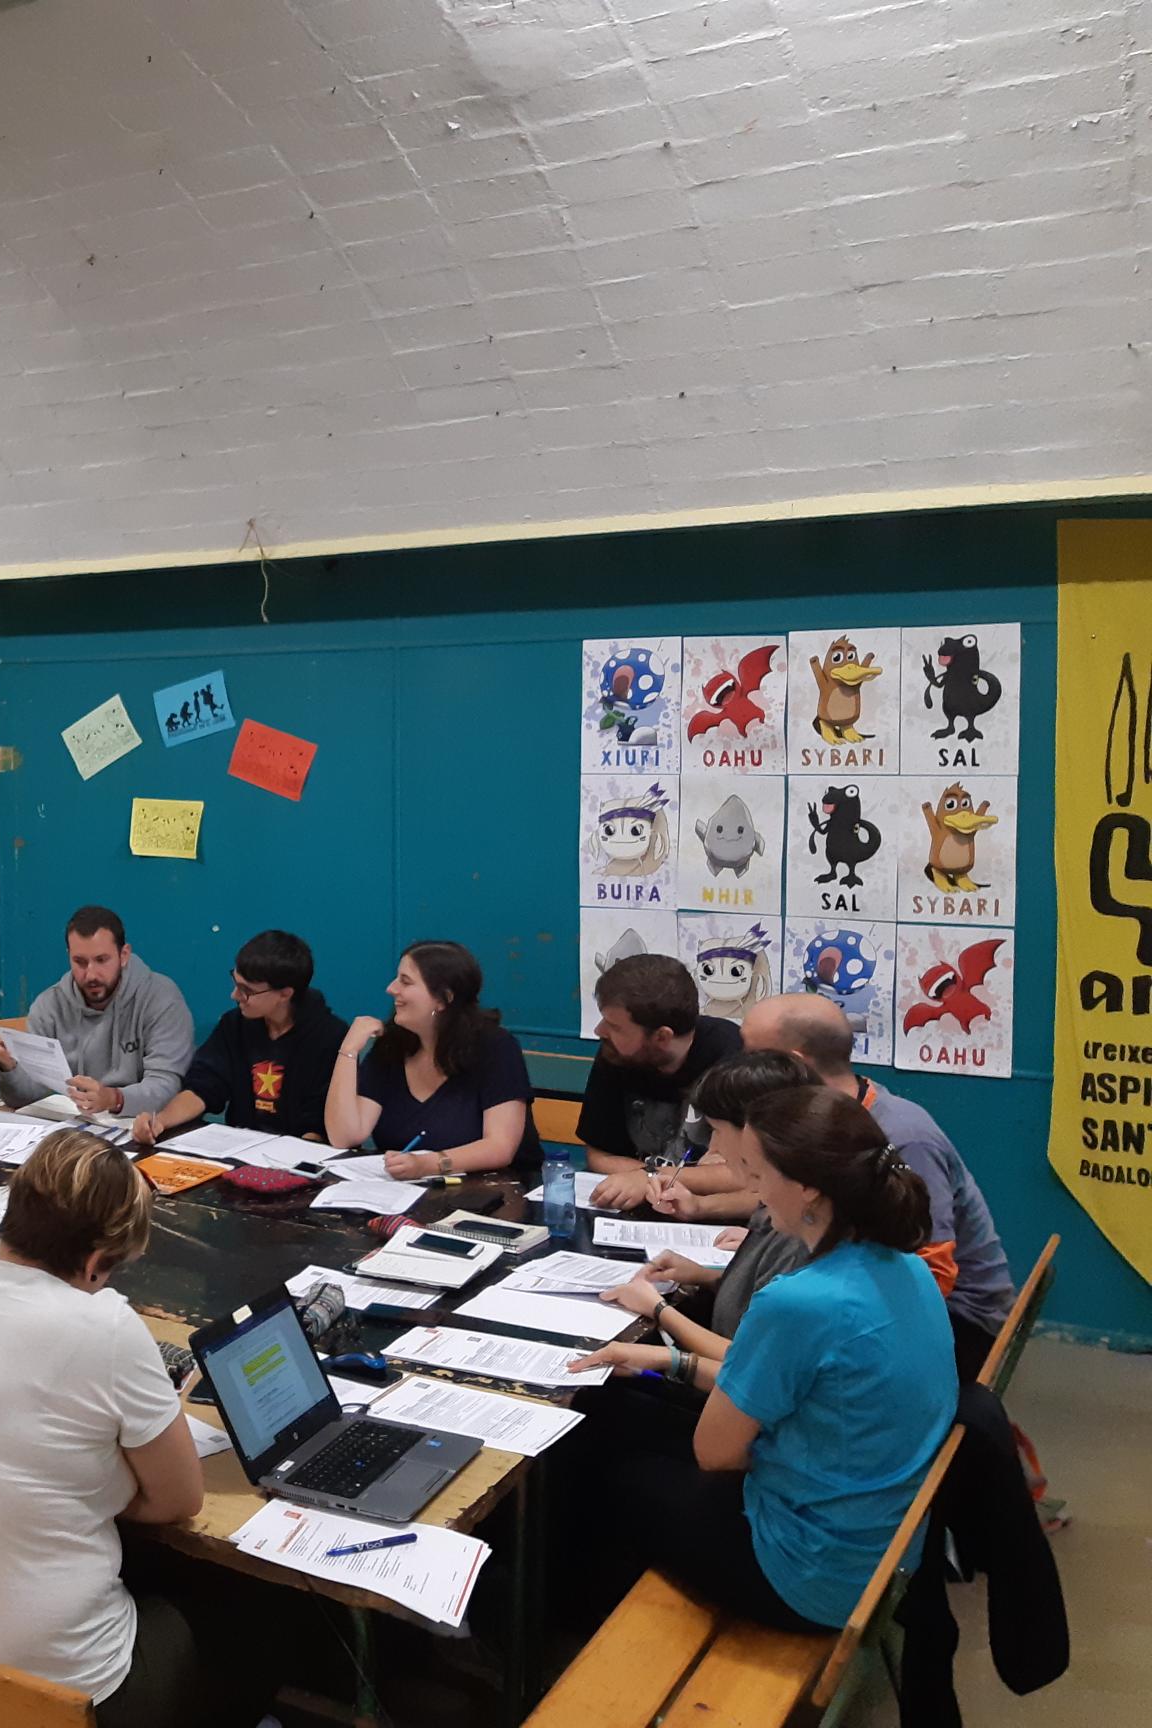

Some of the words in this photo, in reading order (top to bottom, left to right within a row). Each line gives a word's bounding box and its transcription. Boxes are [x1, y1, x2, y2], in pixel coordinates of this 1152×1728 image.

[600, 750, 660, 767] XIURI
[702, 749, 764, 767] OAHU
[801, 748, 885, 767] SYBARI
[938, 747, 980, 767] SAL
[597, 883, 662, 902] BUIRA
[702, 886, 754, 905] NHIR
[821, 892, 861, 912] SAL
[912, 895, 1000, 917] SYBARI
[919, 1044, 986, 1067] OAHU
[1079, 1159, 1152, 1188] BADALO
